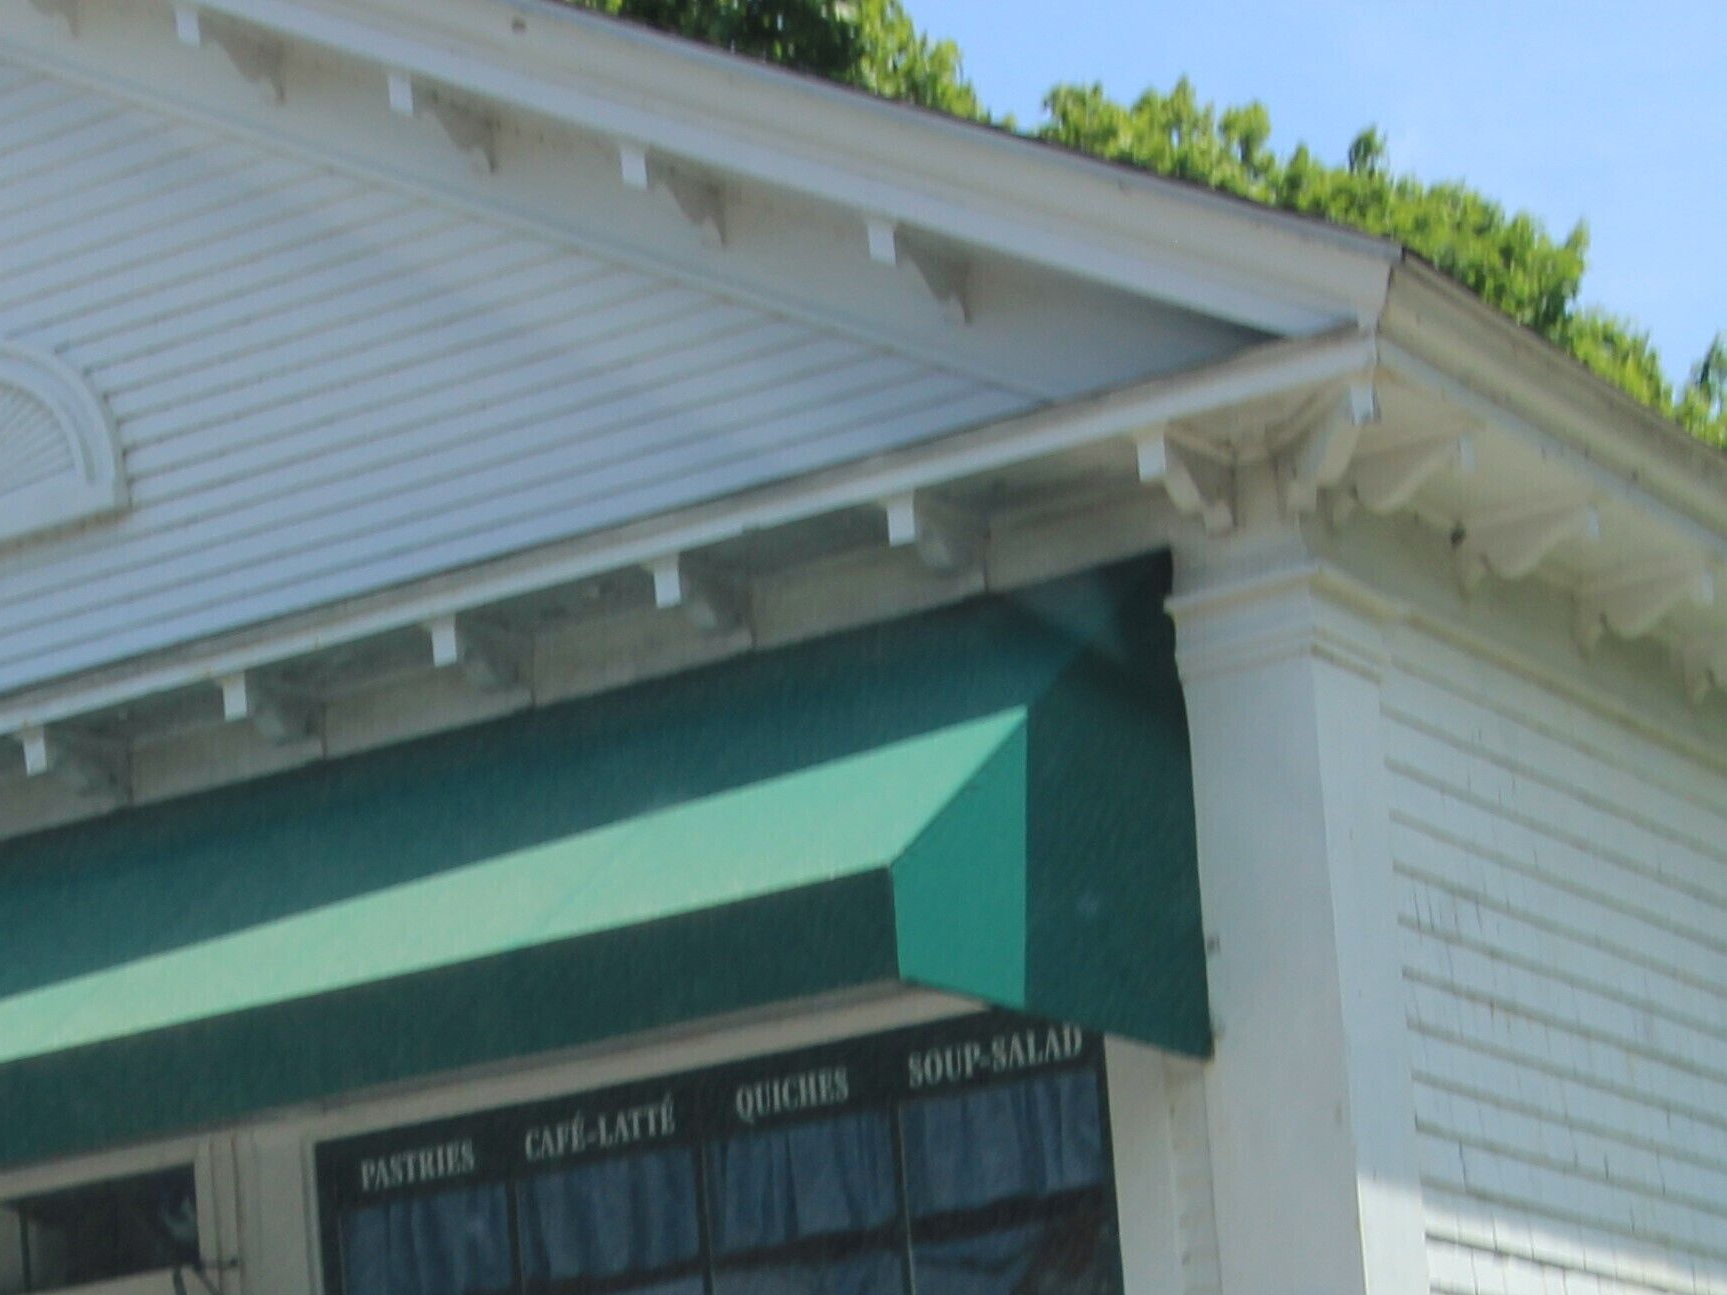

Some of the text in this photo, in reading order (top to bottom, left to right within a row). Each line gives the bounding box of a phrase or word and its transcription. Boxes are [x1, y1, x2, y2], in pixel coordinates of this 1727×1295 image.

[360, 1136, 476, 1193] PASTRIES
[734, 1065, 850, 1125] QUICHES
[907, 1021, 1084, 1088] SOUP-SALAD
